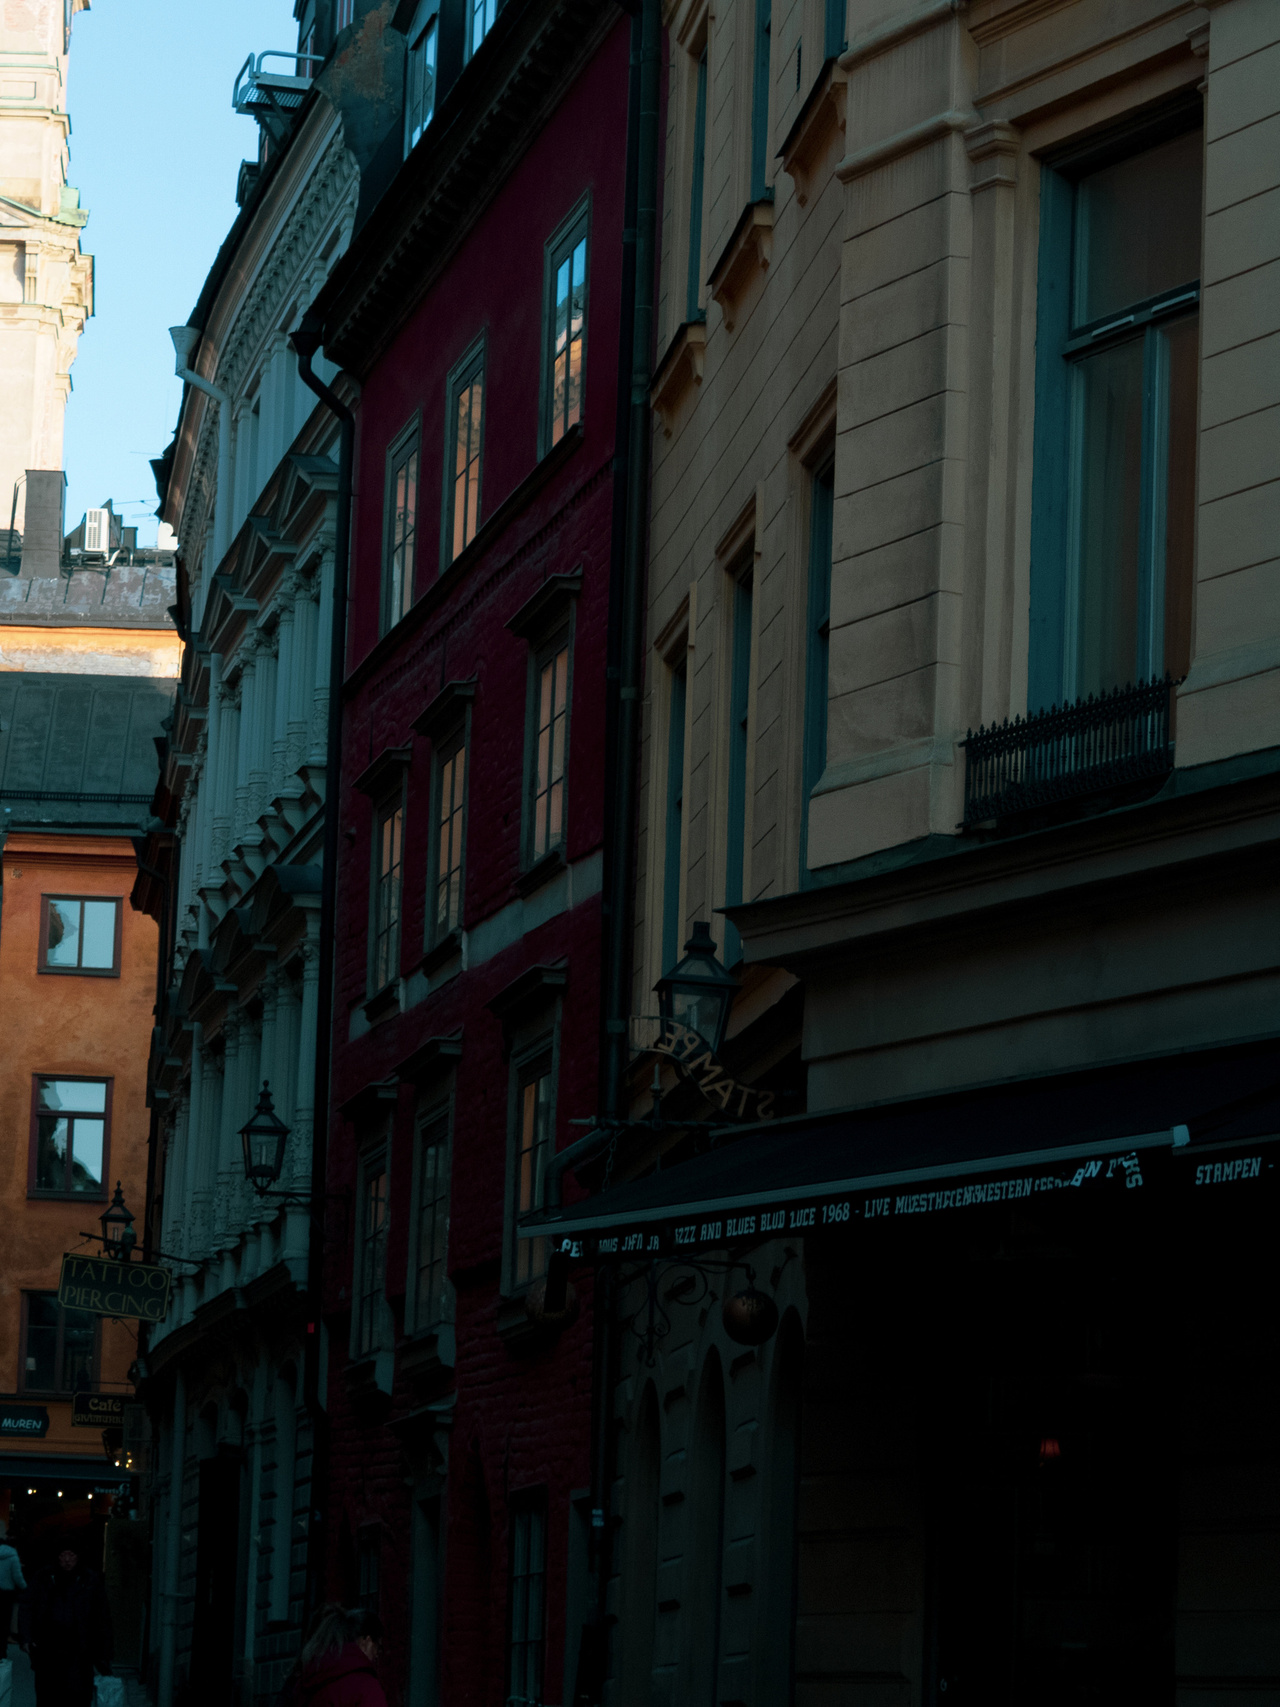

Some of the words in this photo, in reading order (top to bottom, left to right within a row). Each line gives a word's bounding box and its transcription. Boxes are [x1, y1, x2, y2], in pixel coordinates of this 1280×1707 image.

[1194, 1156, 1263, 1186] STAMPEN
[699, 1220, 723, 1241] AND
[725, 1215, 757, 1237] BLUES
[821, 1201, 851, 1224] 1968
[864, 1197, 891, 1219] LIVE
[65, 1258, 167, 1290] TATTOO
[64, 1285, 162, 1317] PIERCING
[1, 1417, 43, 1430] MUREN
